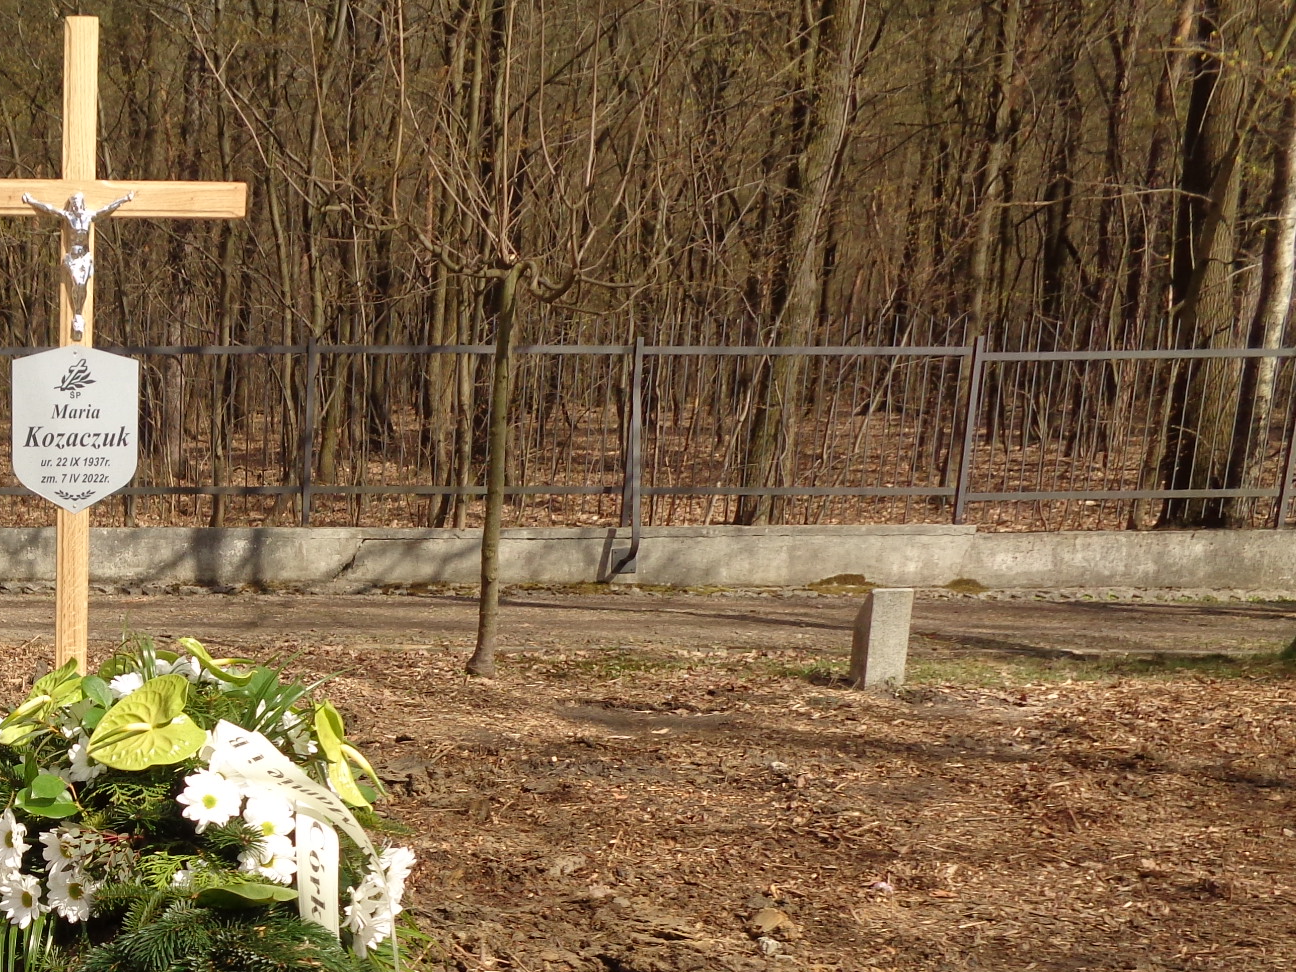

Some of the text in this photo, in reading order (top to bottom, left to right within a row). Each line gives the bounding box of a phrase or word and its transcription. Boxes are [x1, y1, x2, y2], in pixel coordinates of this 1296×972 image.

[51, 403, 101, 420] Maria
[22, 425, 131, 450] Kozaczuk
[40, 457, 111, 467] ur. 22 IX 1937r.
[40, 473, 110, 484] zm. 7 IV 2022r.
